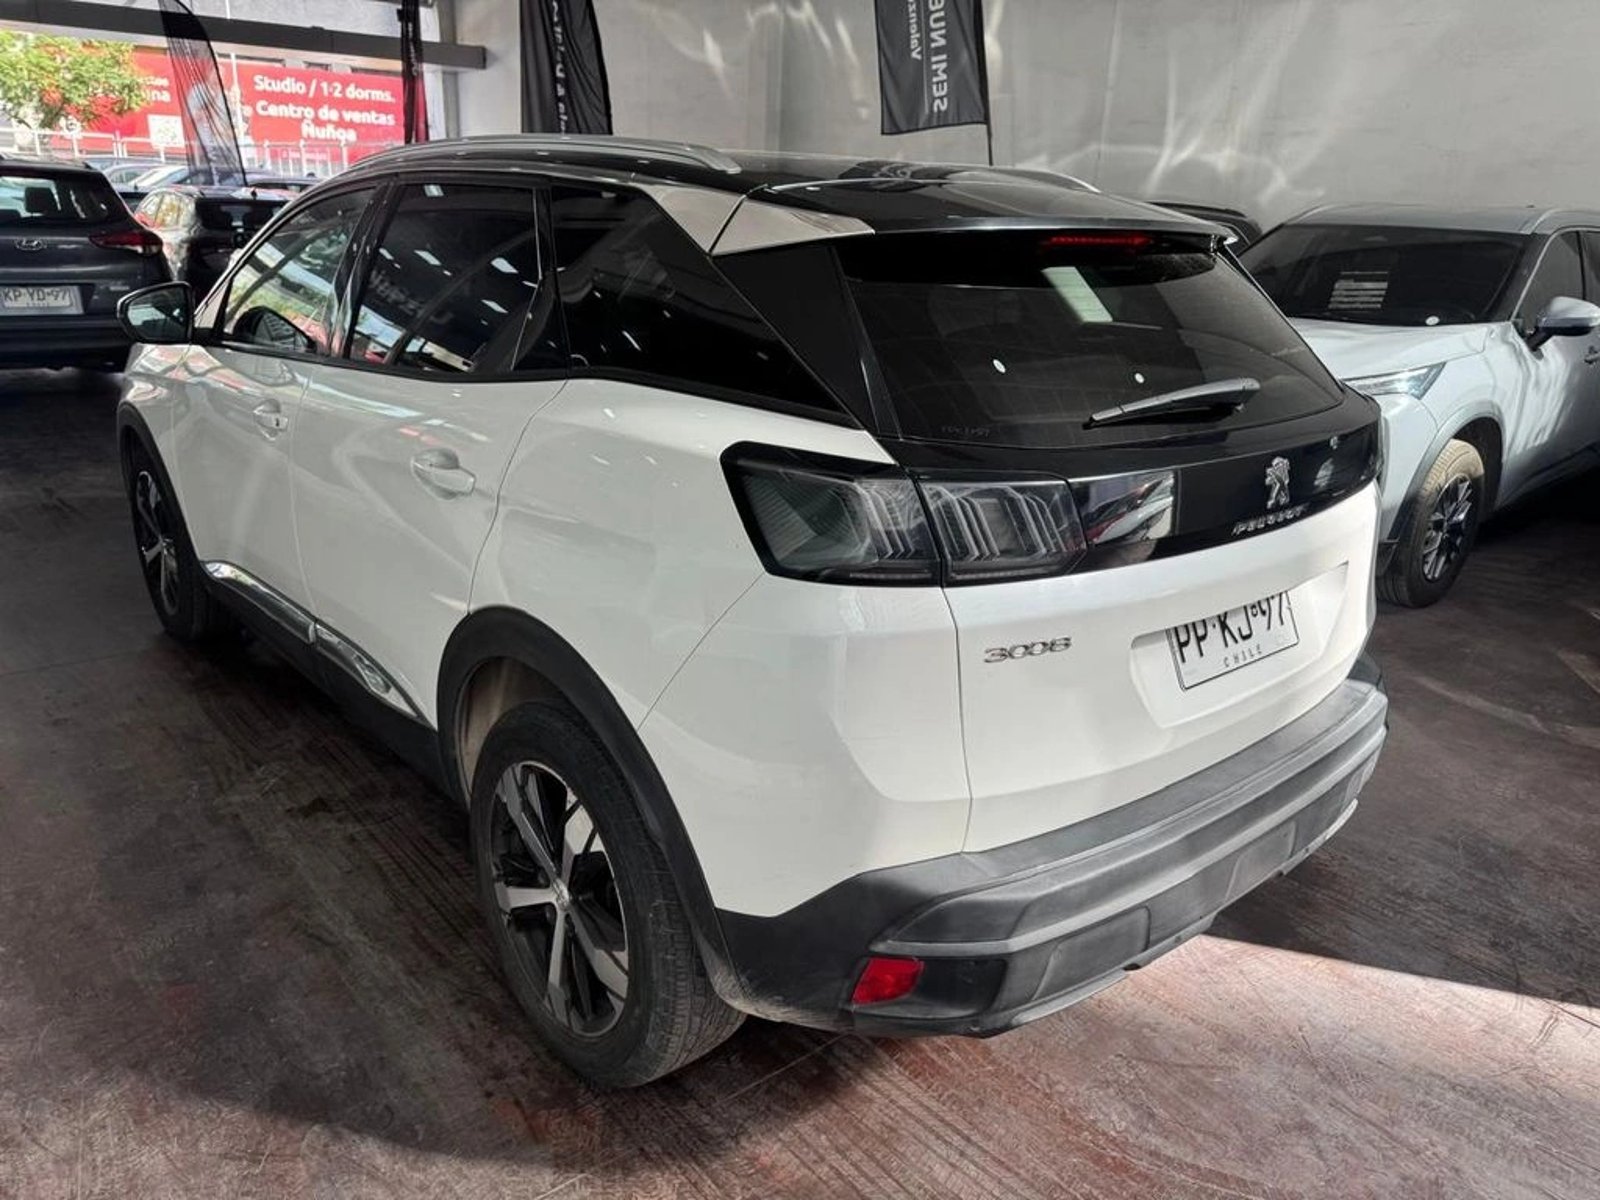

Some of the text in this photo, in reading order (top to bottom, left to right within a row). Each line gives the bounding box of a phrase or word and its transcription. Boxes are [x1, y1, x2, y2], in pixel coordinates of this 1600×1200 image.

[253, 75, 306, 95] Studio
[345, 84, 396, 103] dorms.
[256, 100, 396, 126] Centro de ventas
[1223, 643, 1262, 668] CHILE
